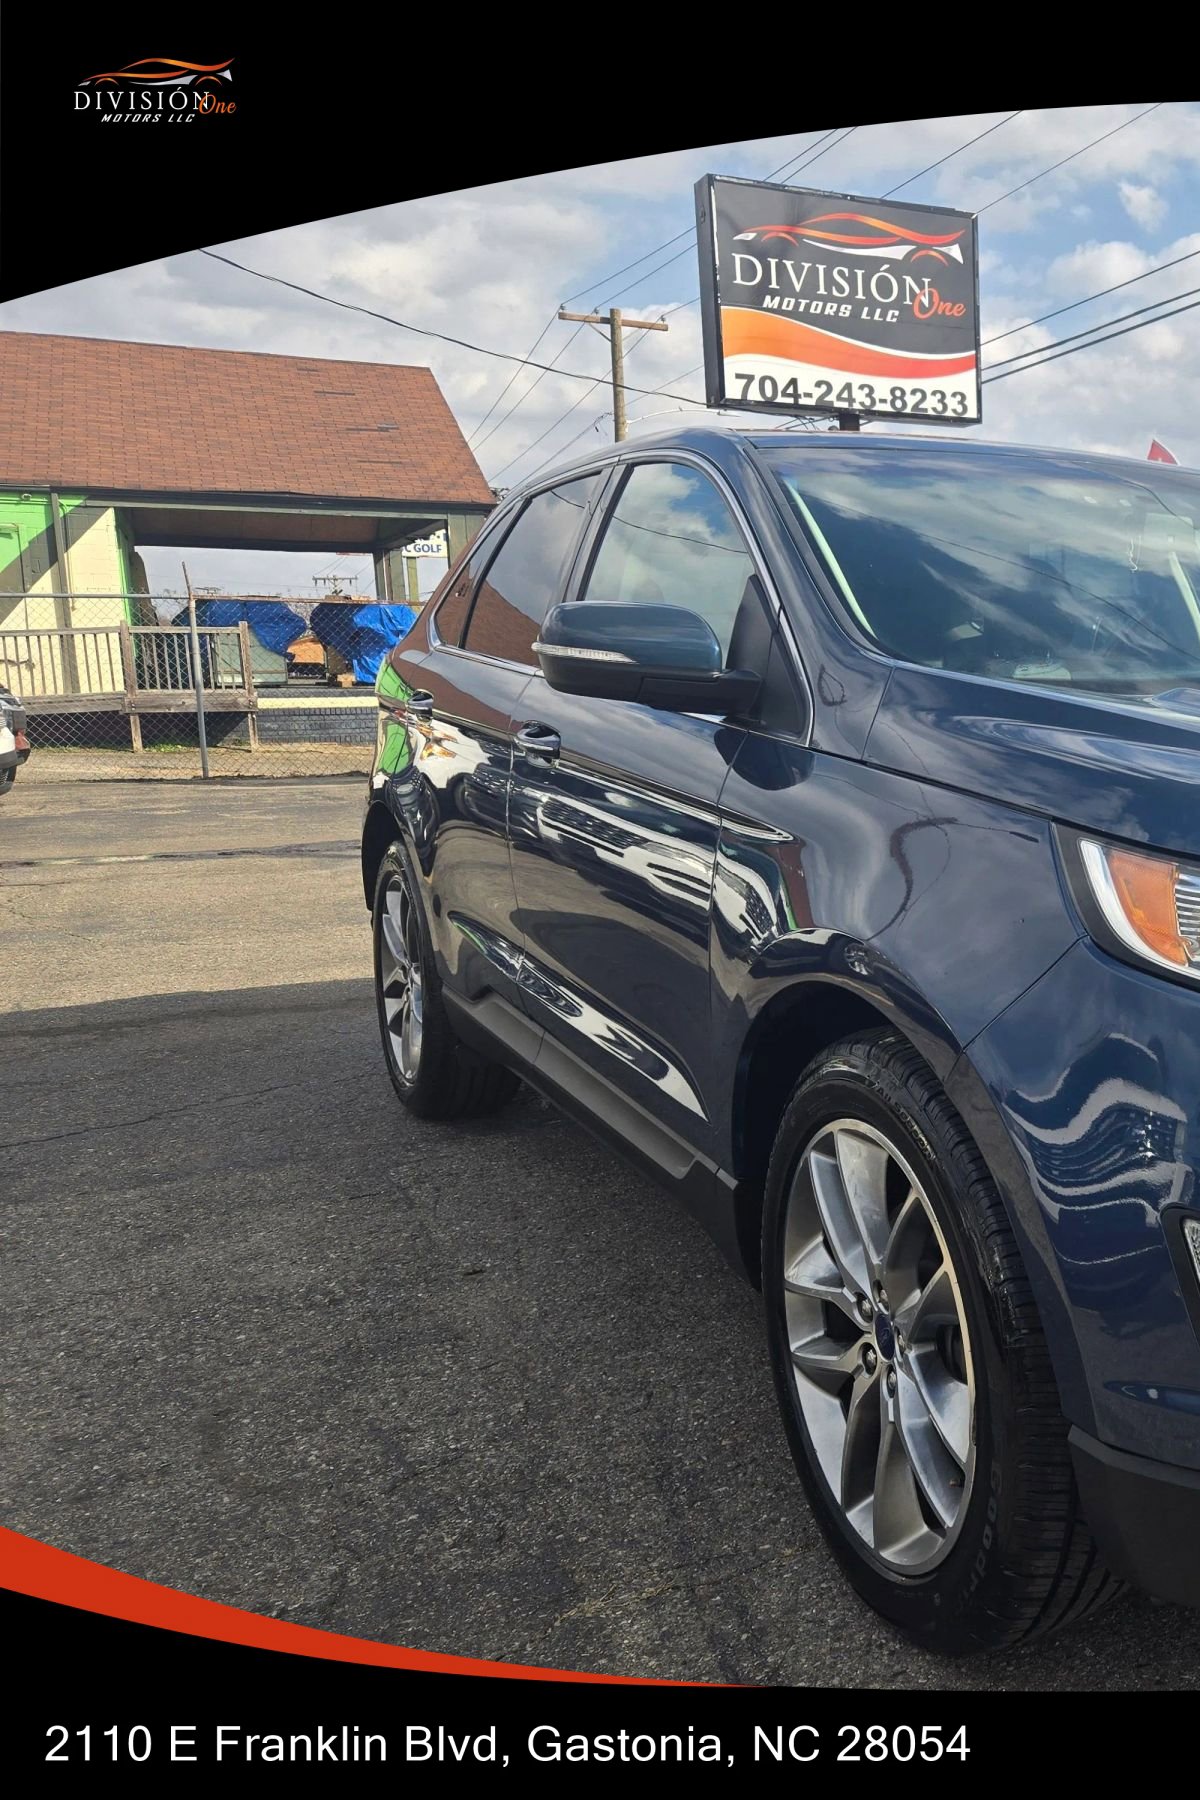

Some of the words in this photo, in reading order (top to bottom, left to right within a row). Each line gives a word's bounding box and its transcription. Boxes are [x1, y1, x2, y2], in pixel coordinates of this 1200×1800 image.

[731, 252, 932, 308] DIVISIÓN
[913, 287, 967, 319] One
[762, 295, 852, 318] MOTORS
[860, 307, 900, 323] LLC
[734, 372, 969, 417] 704-243-8233
[413, 543, 442, 553] GOLF
